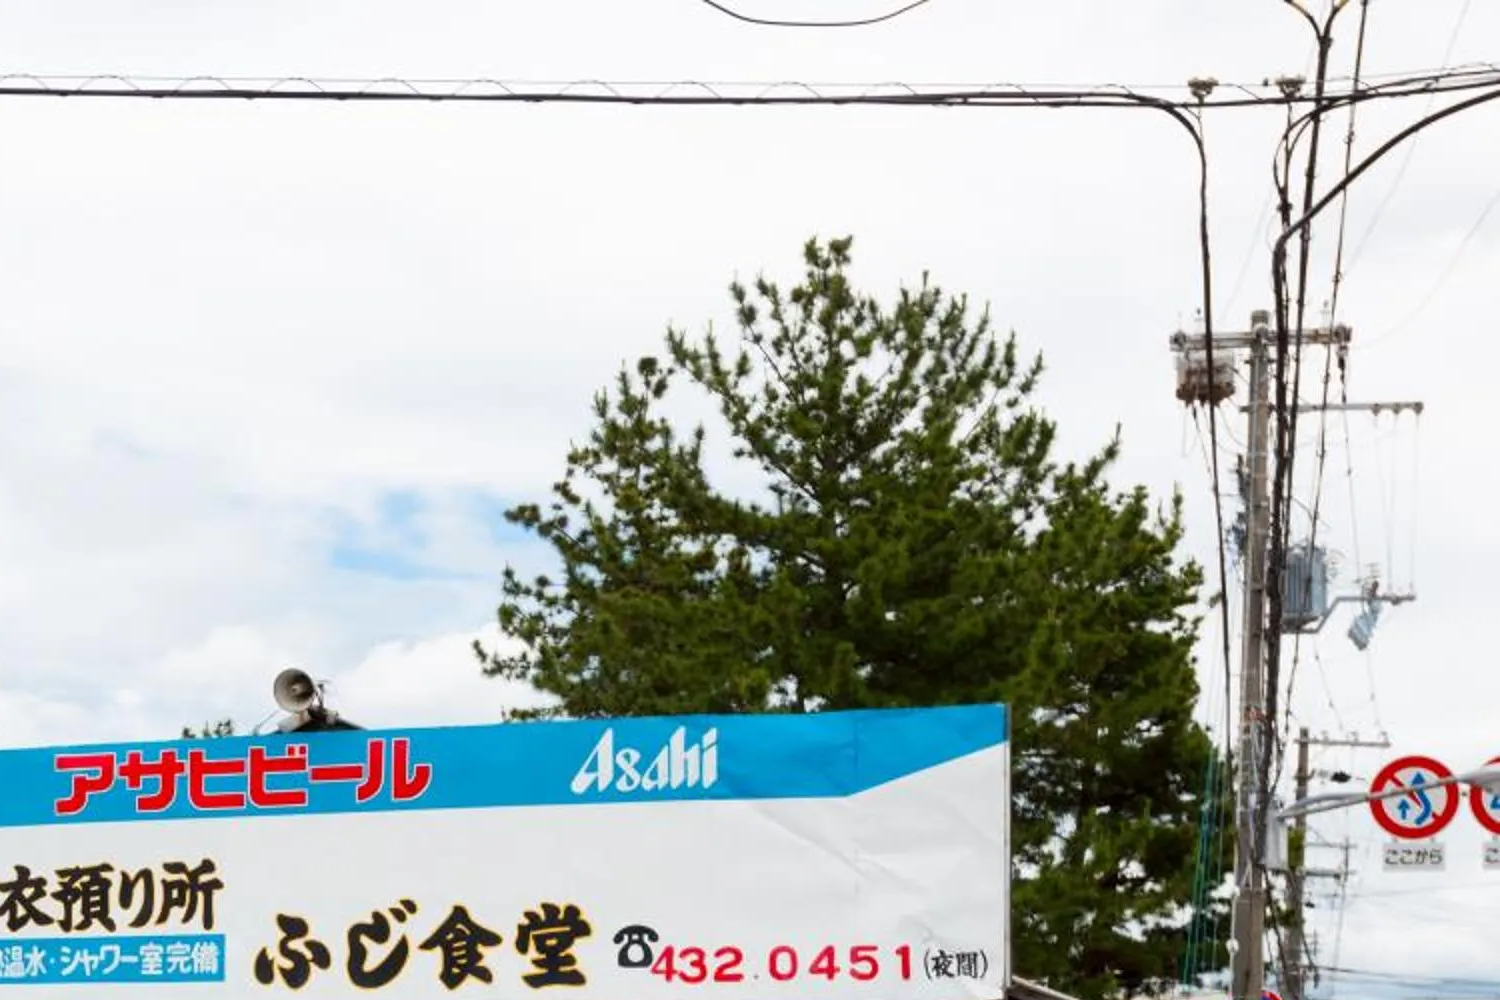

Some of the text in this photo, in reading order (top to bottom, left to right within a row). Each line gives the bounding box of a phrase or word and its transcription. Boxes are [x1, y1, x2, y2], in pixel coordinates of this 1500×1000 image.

[55, 738, 432, 815] アサヒビール
[570, 725, 718, 795] Asahi
[1384, 847, 1444, 865] ここから
[254, 898, 592, 990] ふじ食堂
